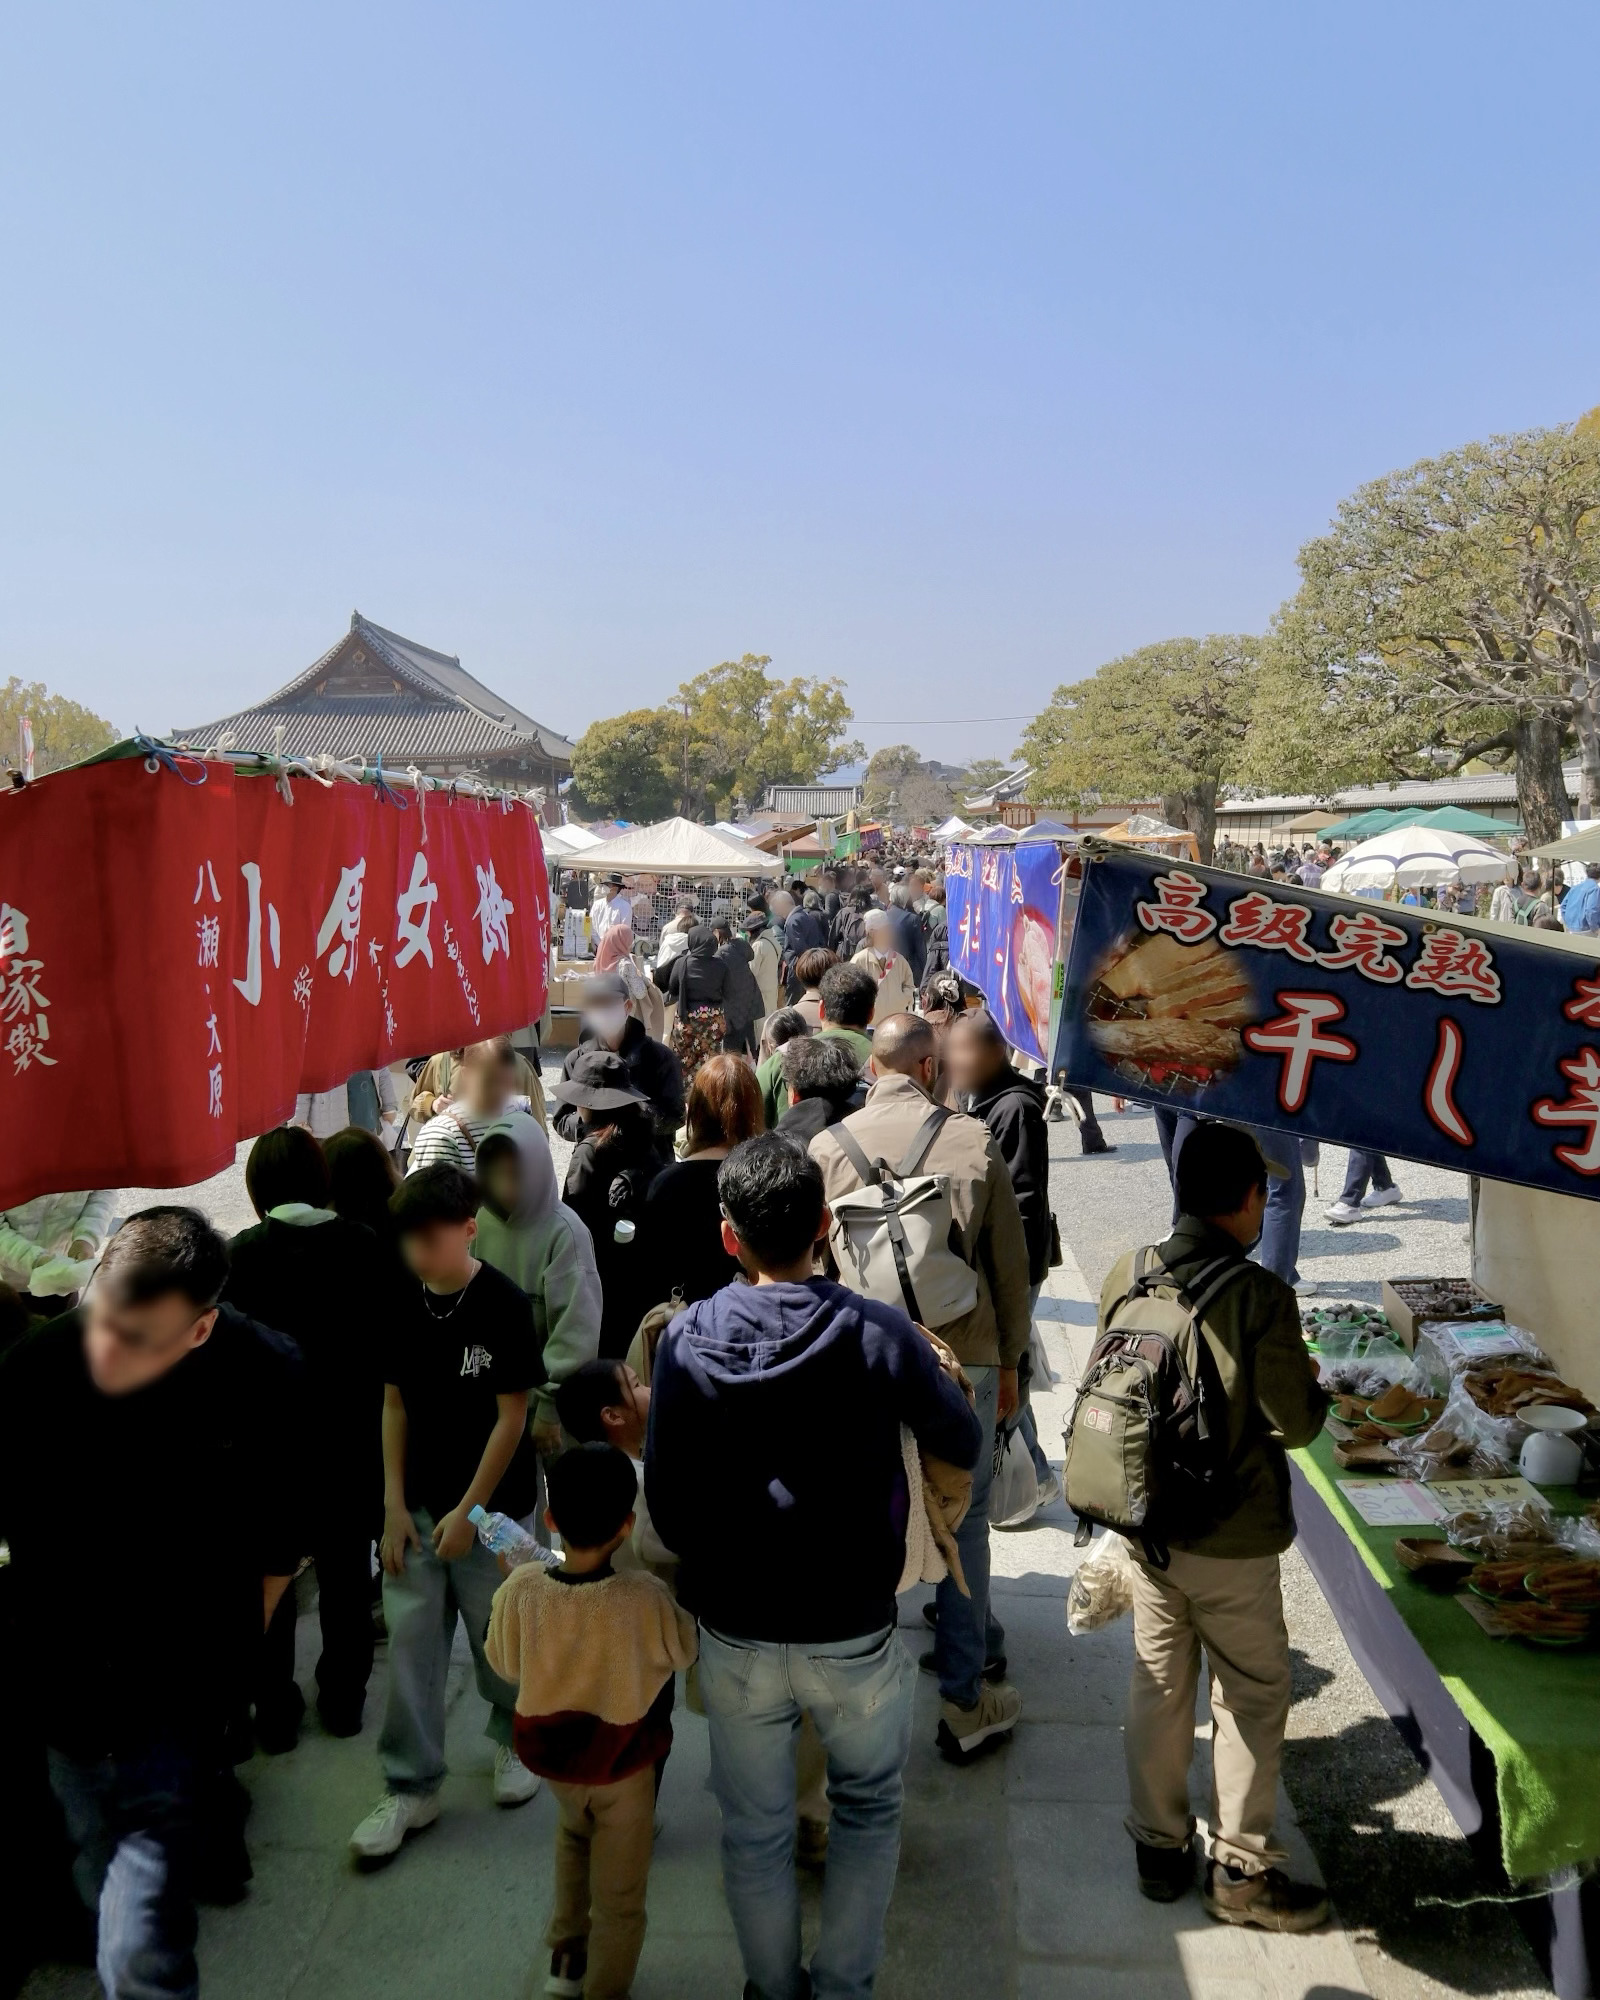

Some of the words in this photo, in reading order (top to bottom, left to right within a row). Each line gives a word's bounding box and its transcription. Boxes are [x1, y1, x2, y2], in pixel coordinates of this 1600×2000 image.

[0, 902, 59, 1077] 自家製
[194, 860, 223, 1118] 八瀬・大原
[233, 852, 514, 1006] 小原女餅
[1137, 870, 1501, 1004] 高級完熟
